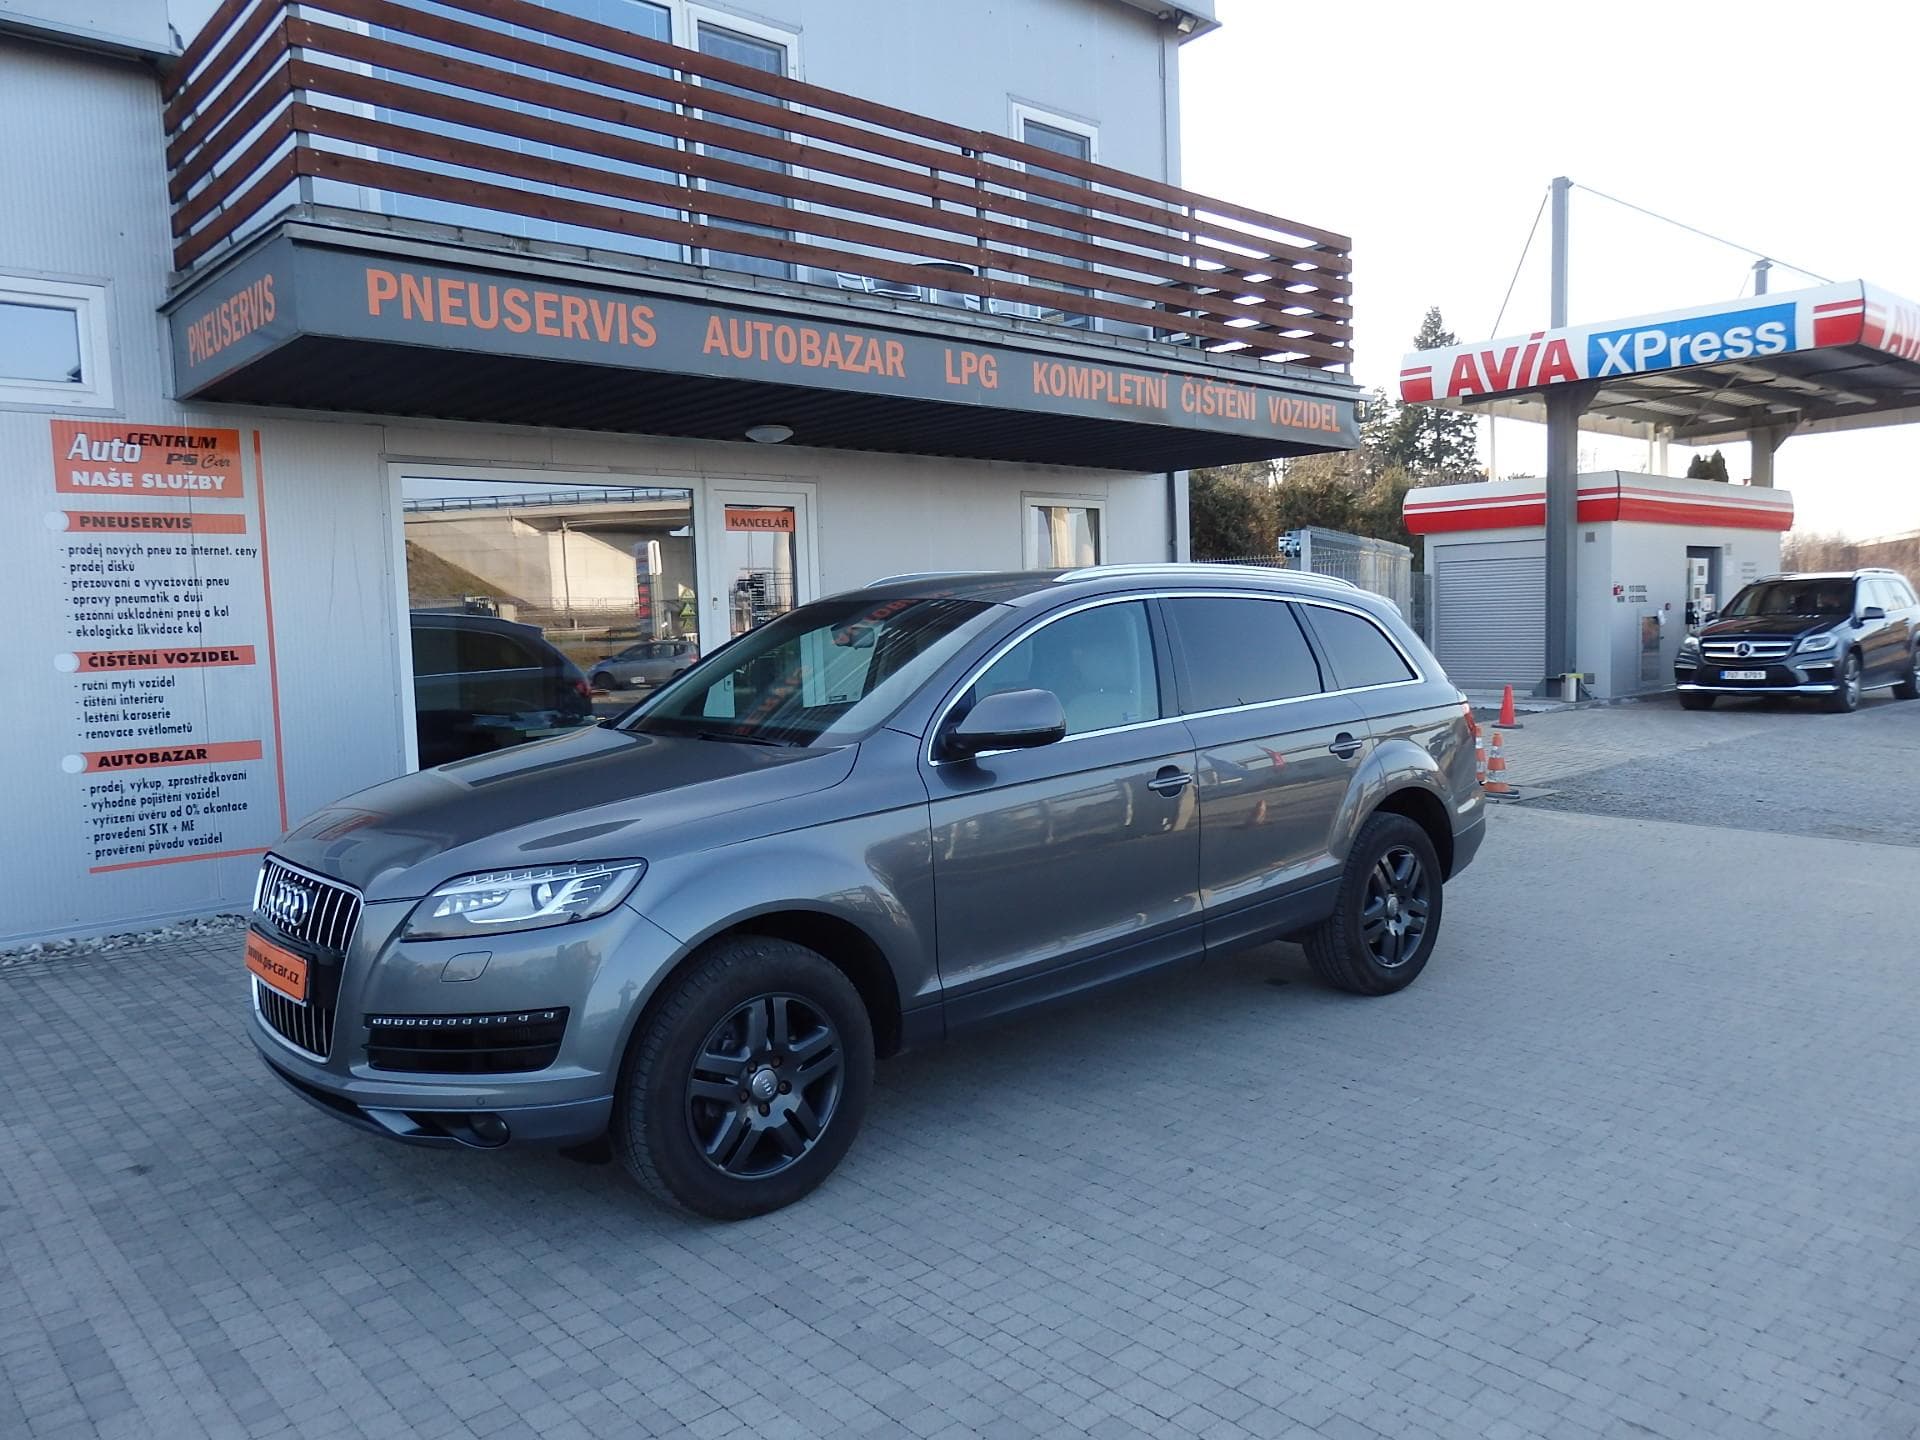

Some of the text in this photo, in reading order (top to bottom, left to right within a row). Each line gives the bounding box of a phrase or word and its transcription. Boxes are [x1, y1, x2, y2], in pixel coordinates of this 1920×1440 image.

[187, 274, 275, 367] PNEUSERVIS
[366, 268, 1340, 432] PNEUSERVIS AUTOBAZAR LPG KOMPLETNÍ ČIŠTĚNÍ VOZIDEL
[1597, 320, 1787, 374] XPress
[66, 432, 217, 463] Auto CENTRUM
[166, 453, 198, 466] PS
[72, 468, 225, 490] NAŠE SLUŽBY
[79, 515, 192, 529] PNEUSERVIS
[731, 516, 789, 528] KANCELÁŘ
[68, 543, 103, 558] prodej
[147, 547, 172, 557] pneu
[175, 547, 187, 555] za
[235, 548, 257, 558] ceny
[70, 560, 104, 575] prodej
[206, 578, 229, 589] pneu
[73, 596, 110, 608] opravy
[115, 591, 170, 607] pneumatik
[177, 610, 201, 620] pneu
[204, 609, 210, 617] a
[214, 605, 229, 617] kol
[137, 623, 183, 635] likvidace
[187, 621, 202, 634] kol
[88, 650, 239, 667] ČIŠTĚNÍ VOZIDEL
[139, 675, 175, 688] vozidel
[123, 707, 171, 720] karoserie
[86, 728, 134, 739] renovace
[98, 748, 208, 767] AUTOBAZAR
[185, 786, 220, 800] vozidel
[170, 805, 182, 817] od
[203, 802, 248, 814] akontace
[149, 822, 169, 835] STK
[182, 820, 195, 832] ME
[149, 837, 184, 854] původu
[188, 831, 222, 846] vozidel
